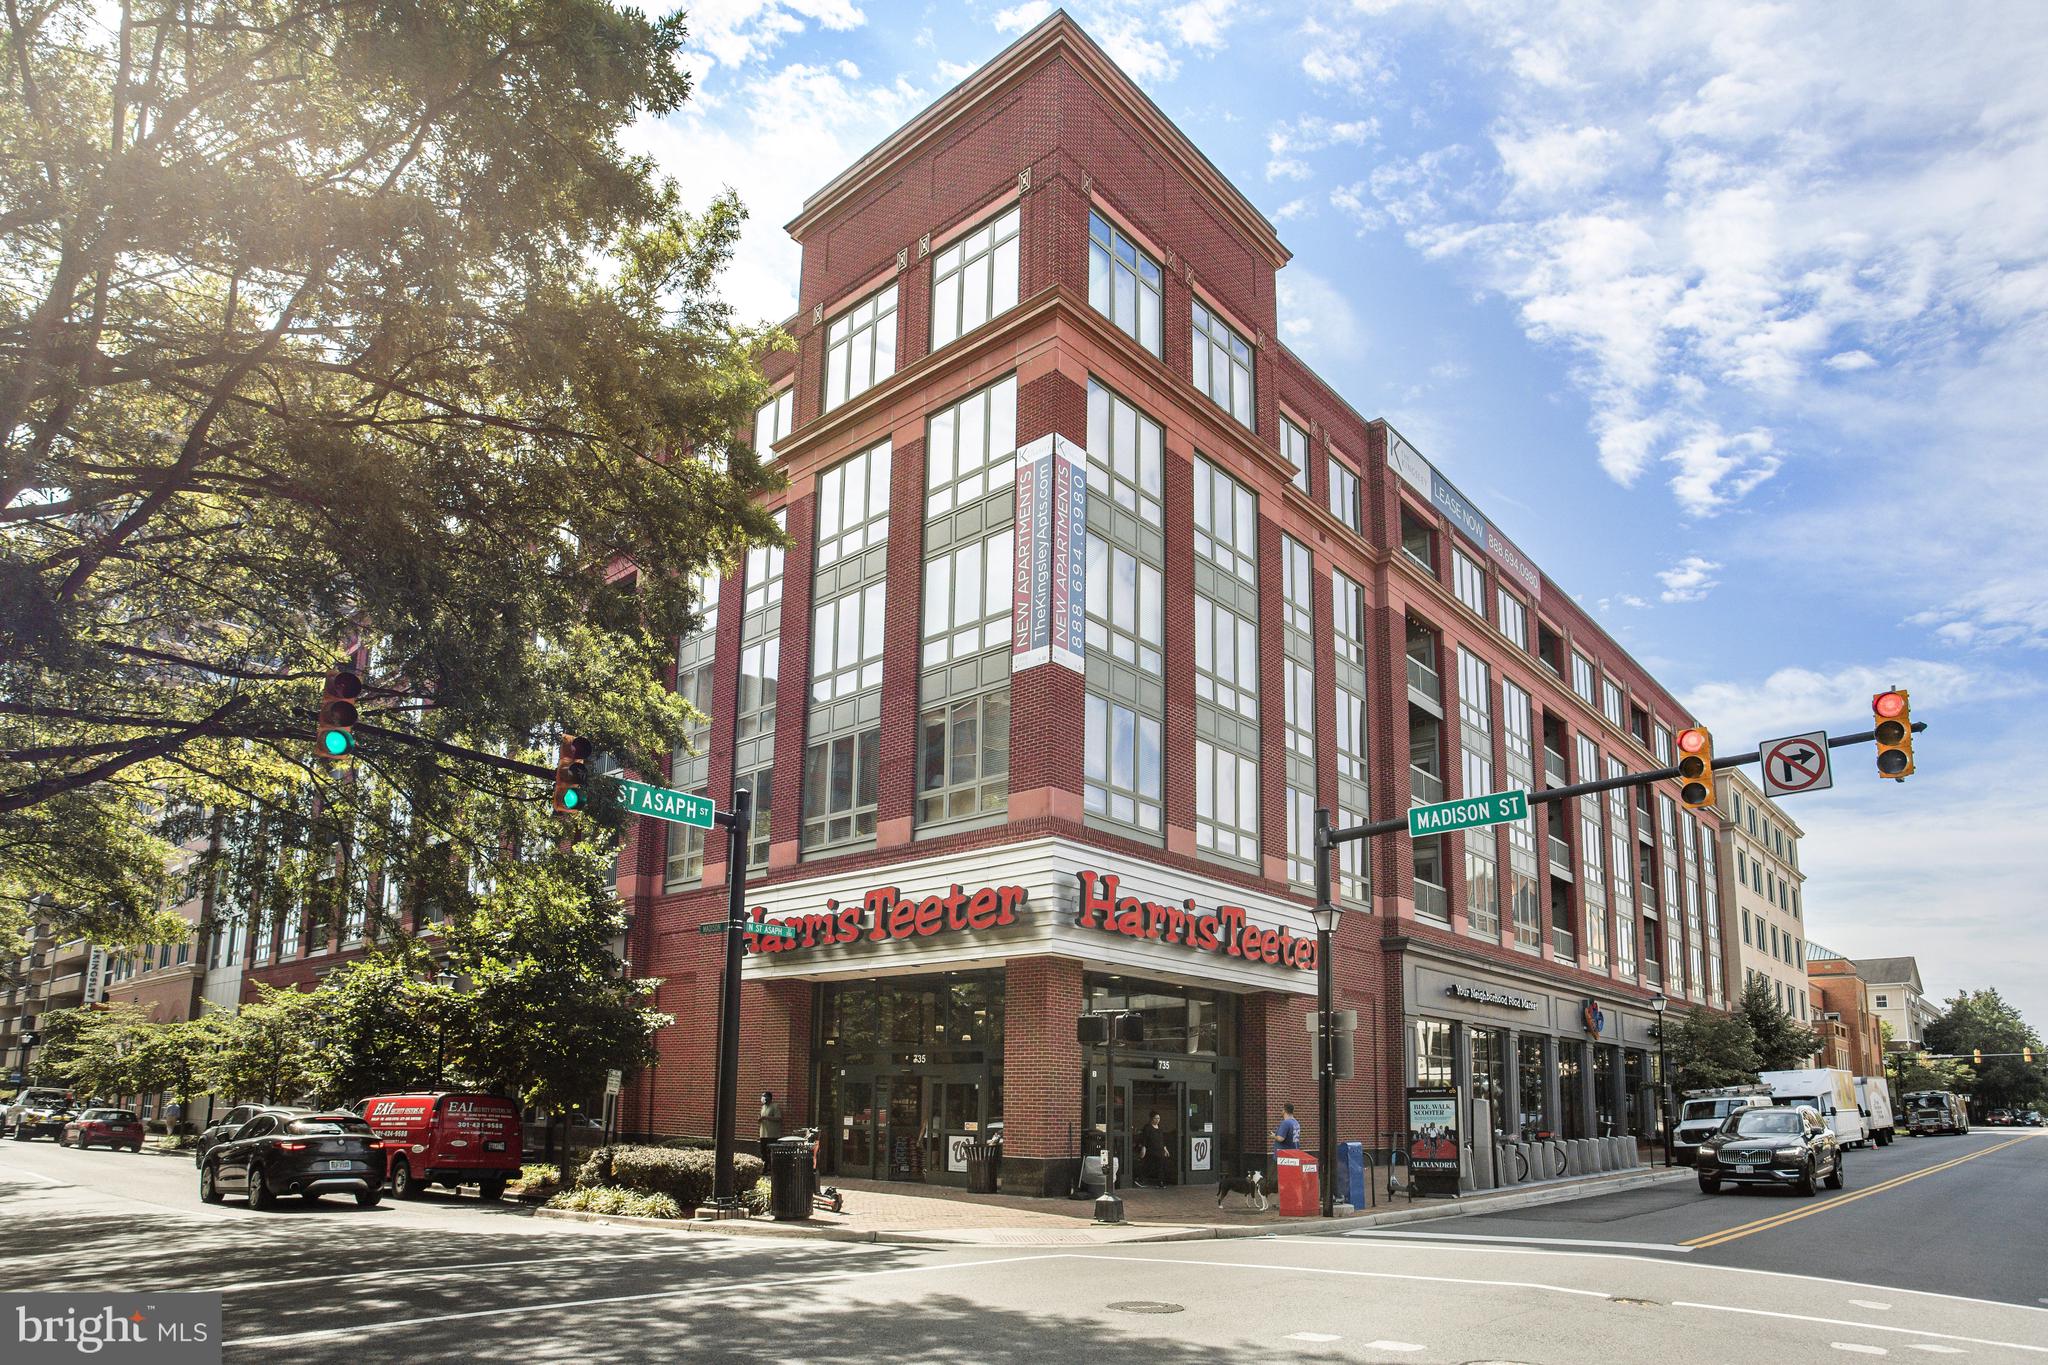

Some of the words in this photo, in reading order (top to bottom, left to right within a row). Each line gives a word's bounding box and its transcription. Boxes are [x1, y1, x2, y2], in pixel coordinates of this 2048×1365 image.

[1018, 470, 1032, 594] APARTMENTS
[1056, 464, 1069, 592] APARTMENTS
[1434, 481, 1461, 519] LEASE
[1462, 510, 1483, 538] NOW
[1035, 462, 1050, 641] TheKingsleyApts.com
[1072, 475, 1084, 649] 888.694.0980
[1487, 533, 1539, 589] 888.694.0980
[1016, 602, 1029, 648] NEW
[1056, 593, 1067, 642] NEW
[617, 784, 638, 806] ST
[641, 792, 697, 819] ASAPH
[699, 807, 709, 817] ST
[1417, 801, 1491, 830] MADISON
[1499, 797, 1519, 817] ST
[748, 923, 753, 931] N
[755, 924, 763, 933] ST
[765, 926, 783, 935] ASAPH
[864, 883, 1028, 942] Teeter
[1074, 870, 1219, 950] Harris
[1455, 984, 1470, 997] Your
[1470, 987, 1508, 1005] Neighborhood
[1508, 995, 1521, 1008] Food
[1158, 1060, 1170, 1070] 735
[373, 1102, 396, 1116] EAI
[448, 1101, 474, 1112] EAI
[1411, 1161, 1457, 1169] ALEXANDRIA
